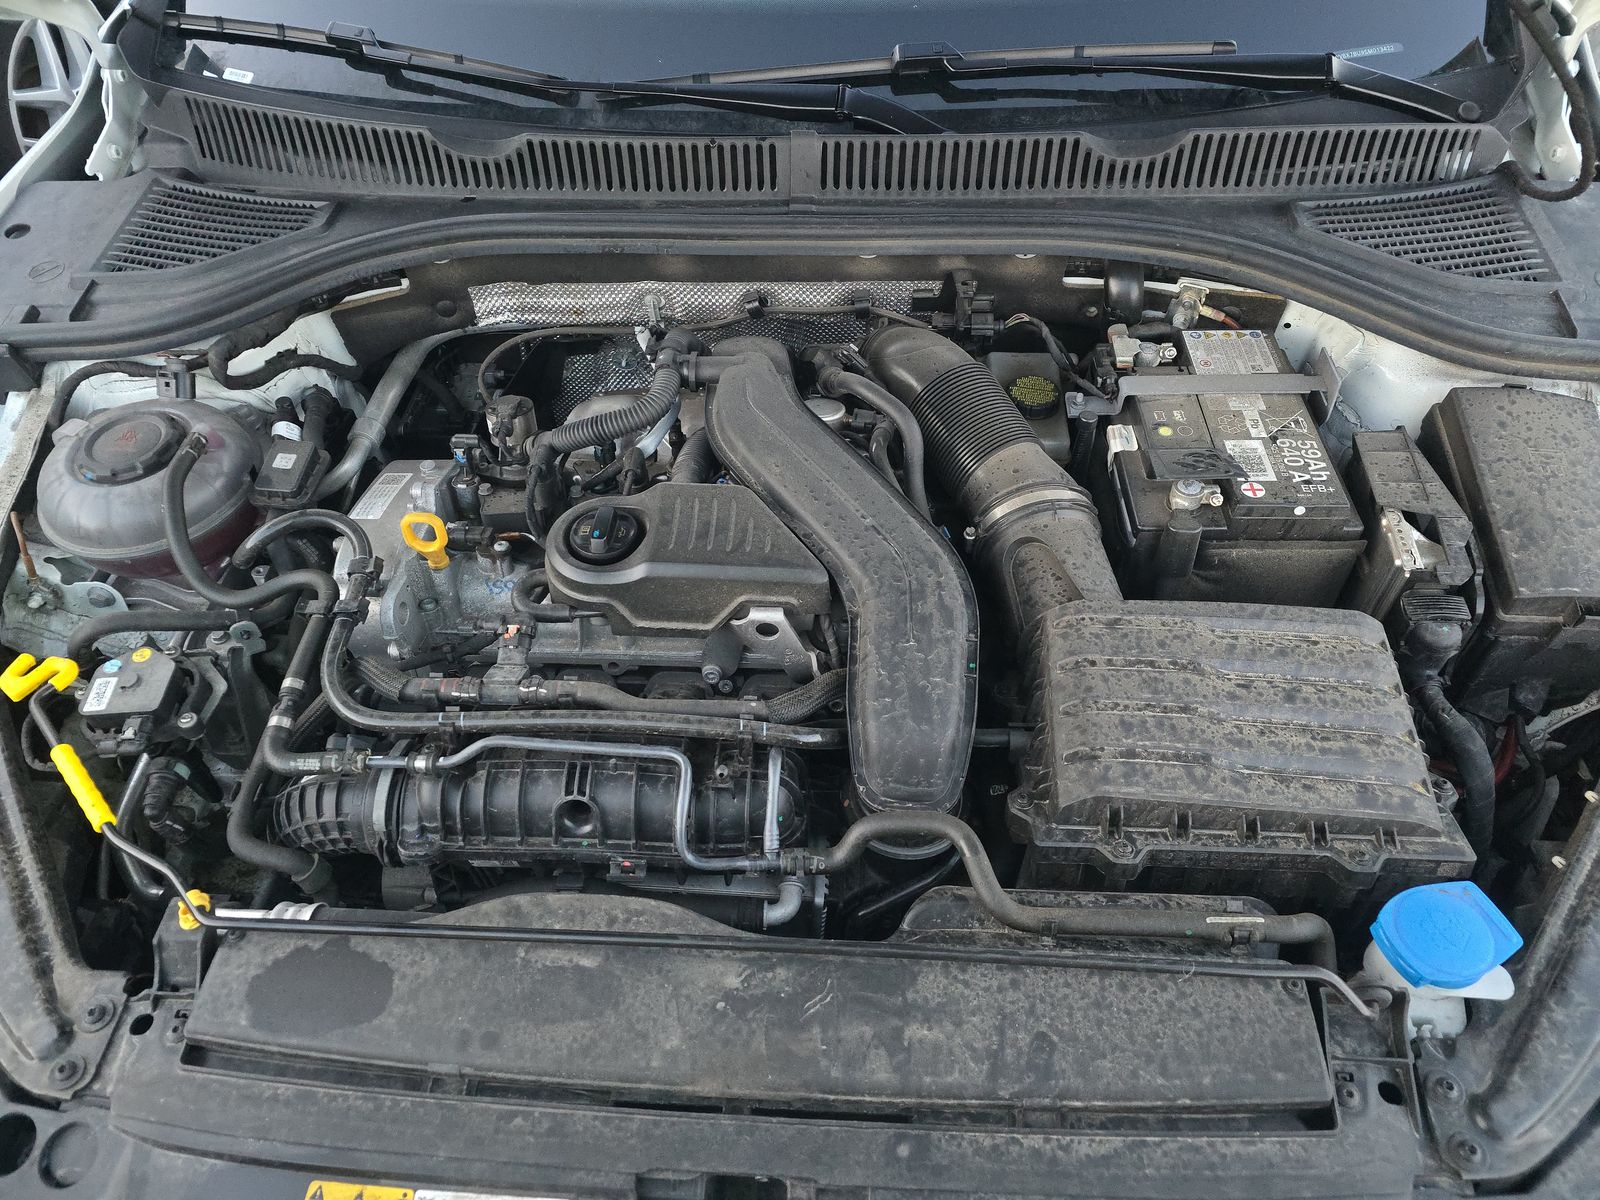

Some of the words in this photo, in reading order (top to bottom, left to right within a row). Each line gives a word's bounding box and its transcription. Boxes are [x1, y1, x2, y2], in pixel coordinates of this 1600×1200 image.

[1249, 418, 1260, 429] Pb
[1276, 438, 1305, 467] 640
[1297, 440, 1331, 481] 59Ah
[1288, 470, 1312, 483] A
[1300, 484, 1336, 493] EFB+
